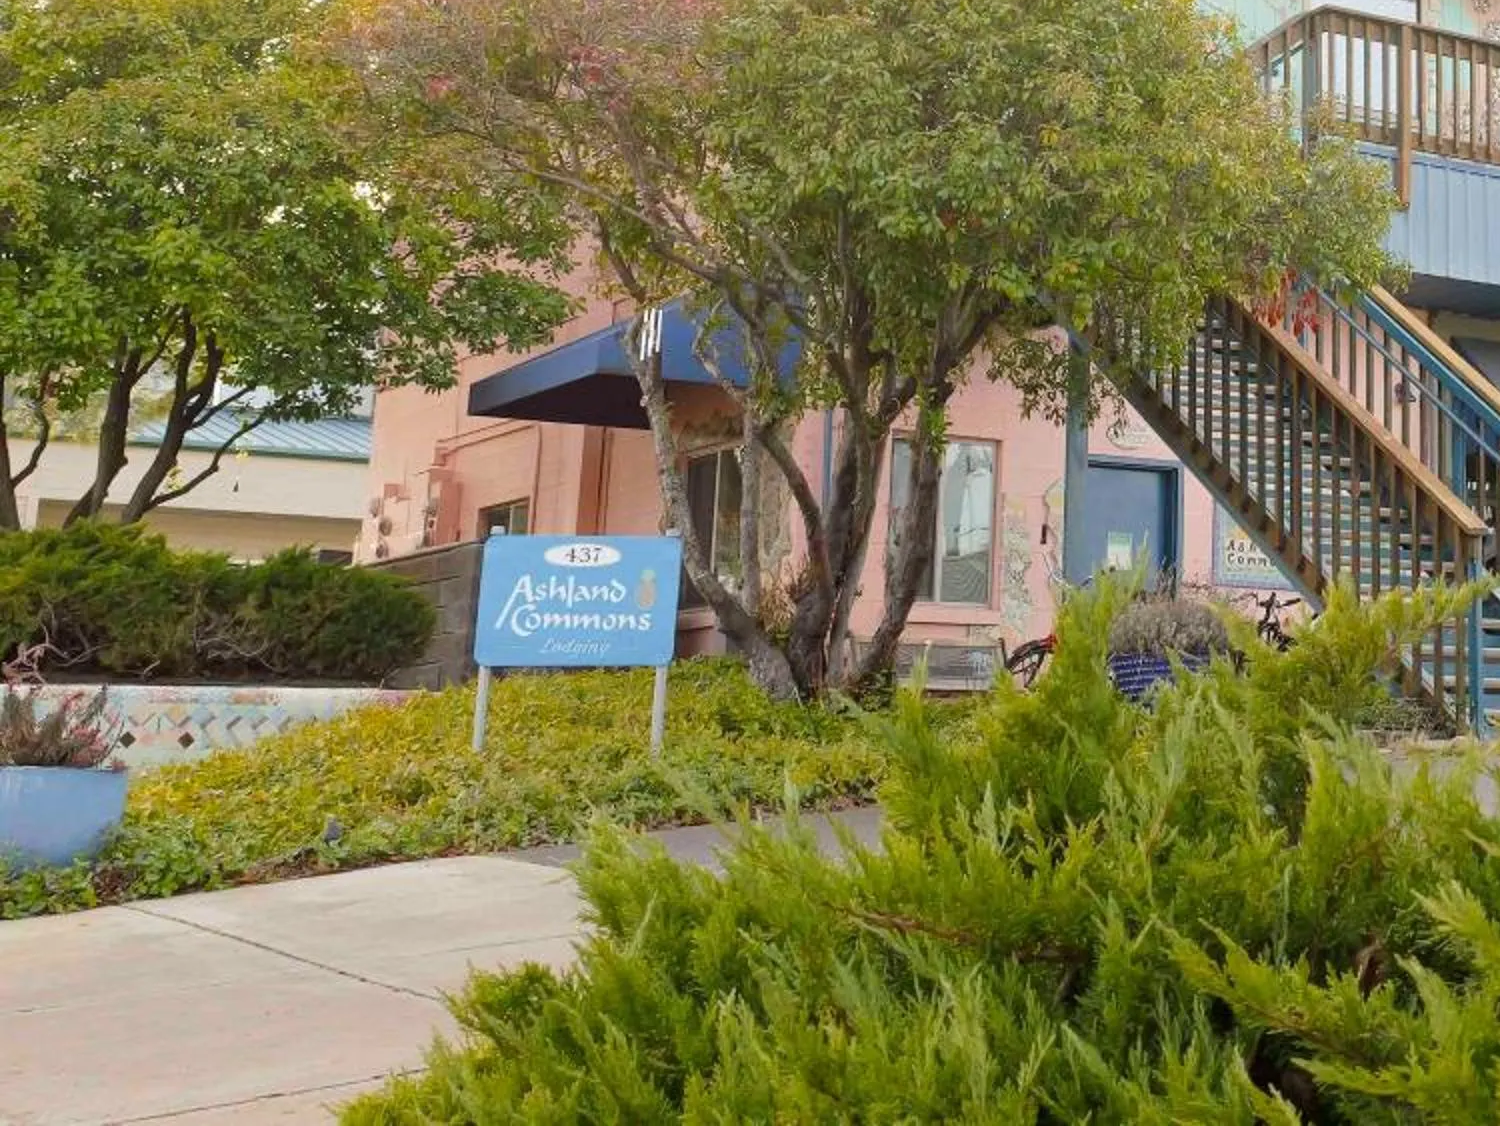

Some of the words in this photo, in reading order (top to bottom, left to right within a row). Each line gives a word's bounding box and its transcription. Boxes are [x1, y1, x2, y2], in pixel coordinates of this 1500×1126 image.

[565, 547, 602, 563] 437
[495, 574, 627, 629] Ashland
[511, 603, 653, 637] Commons
